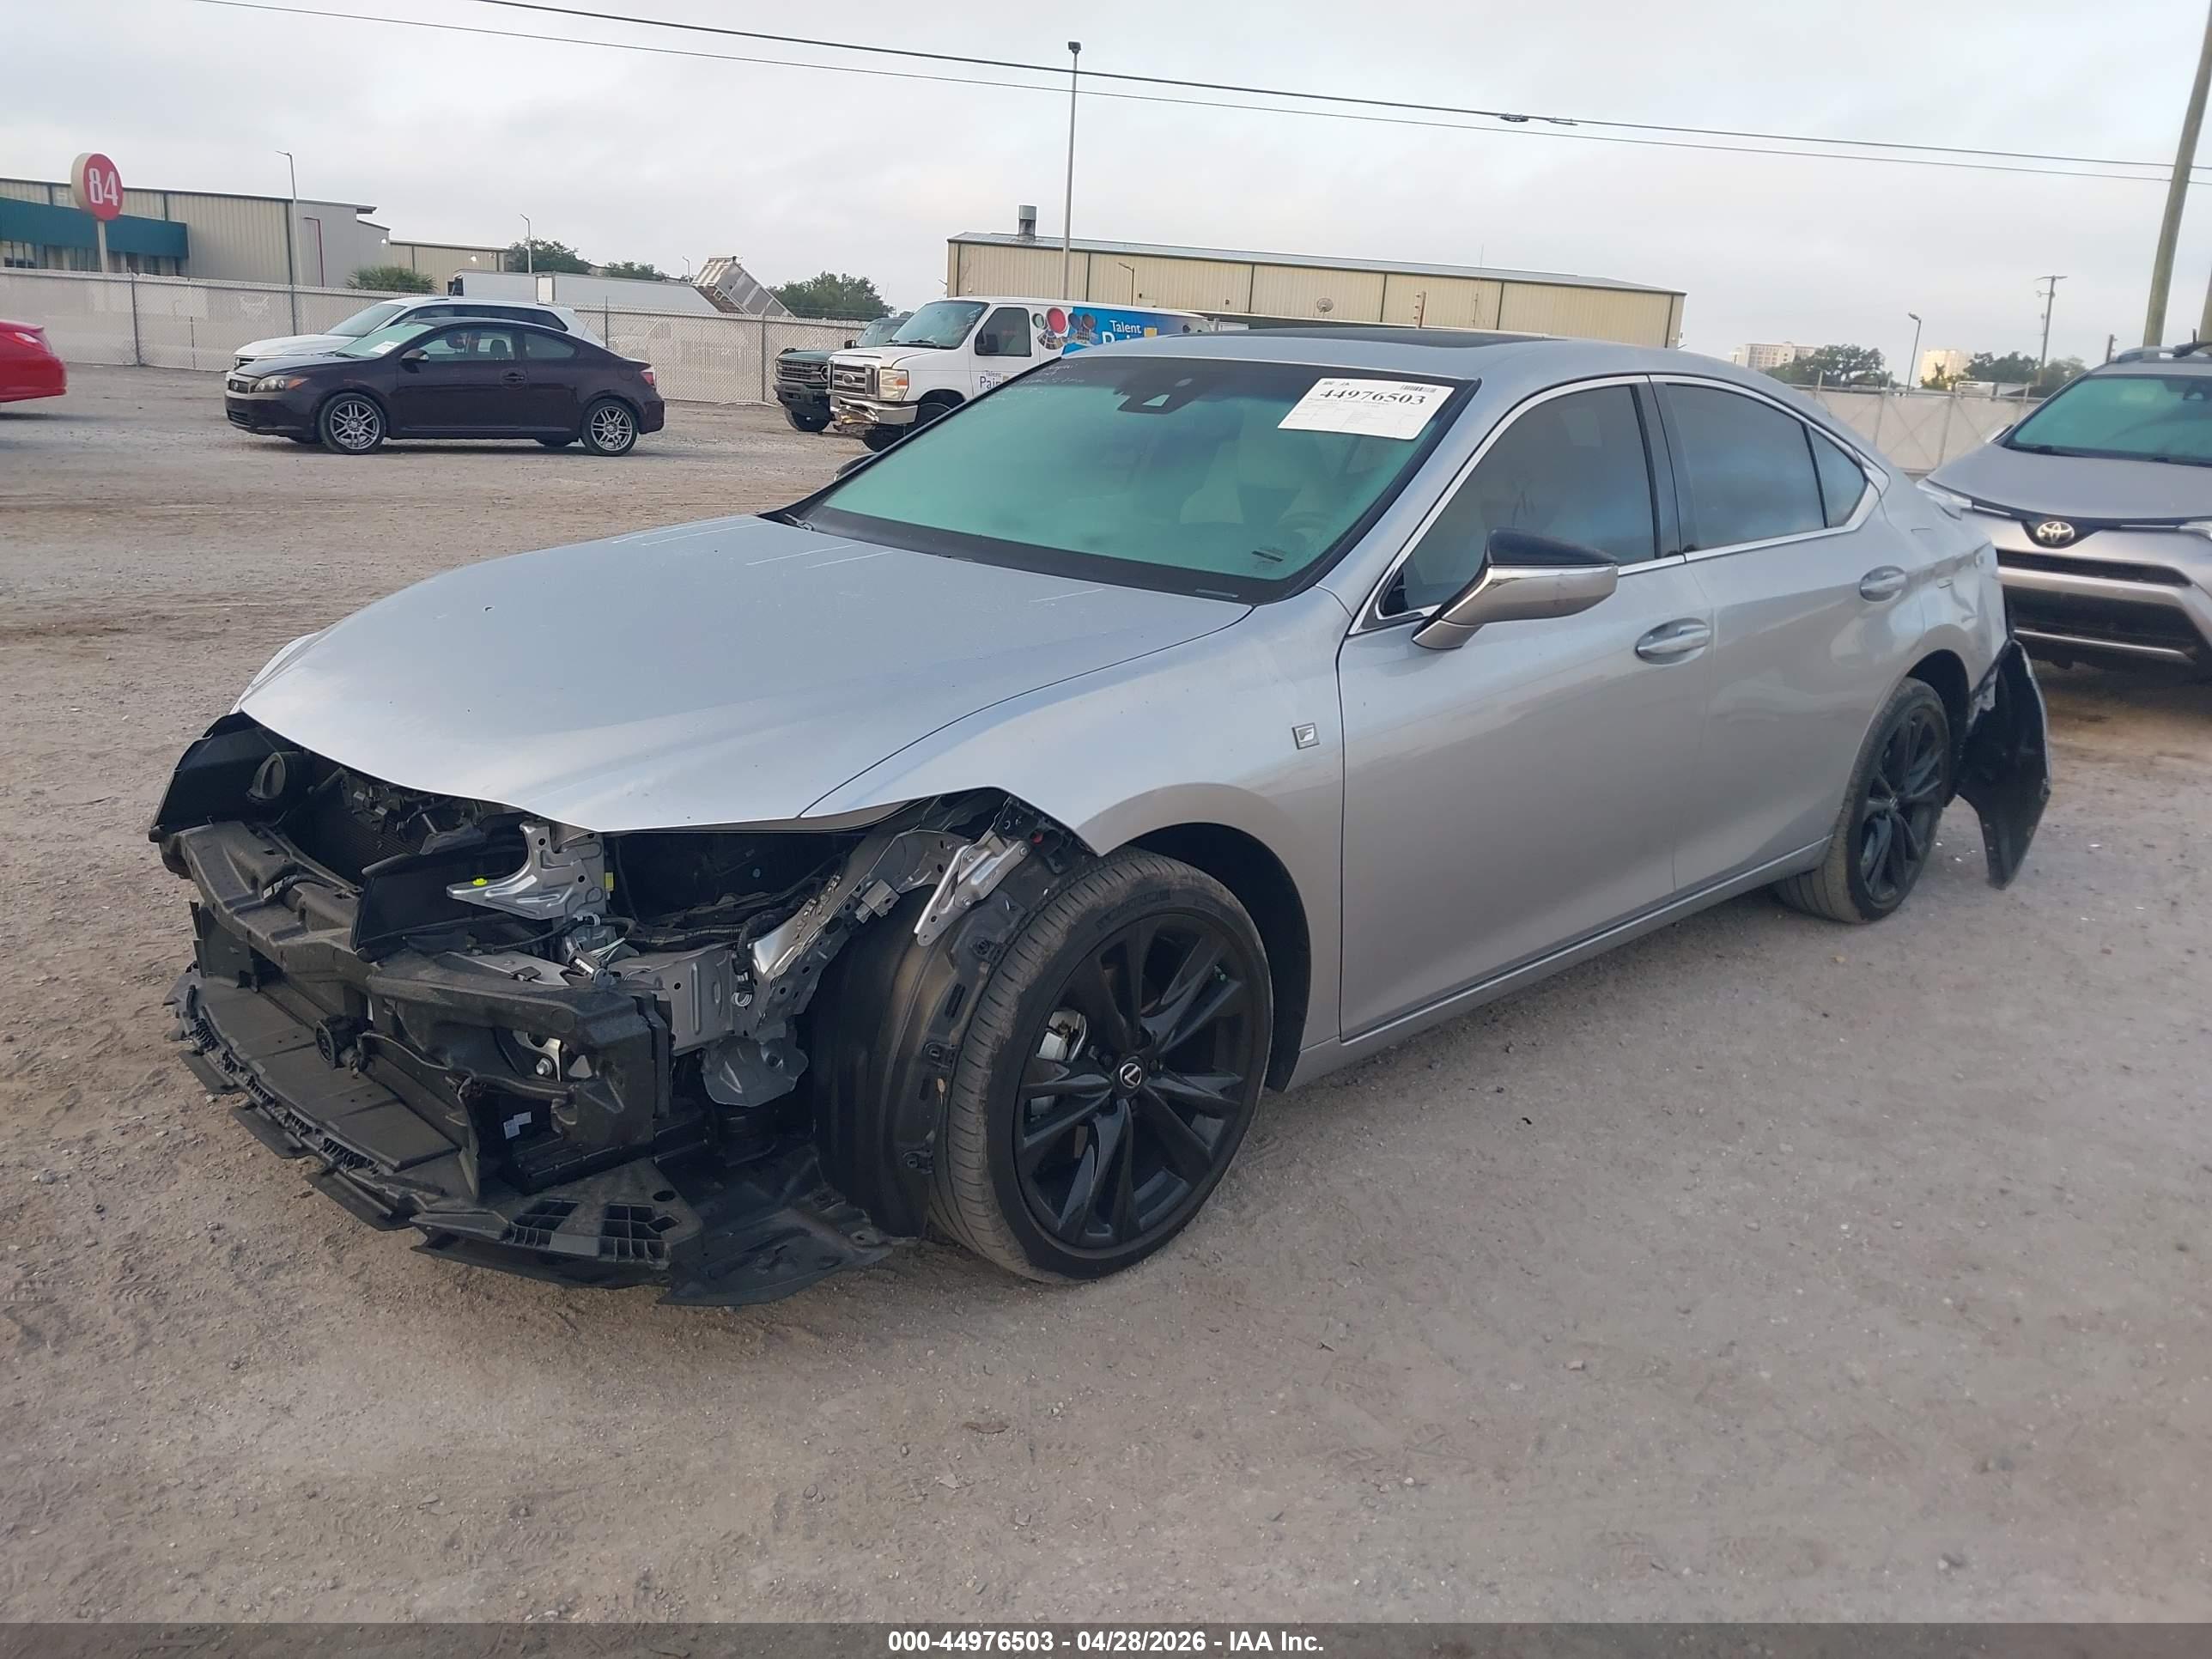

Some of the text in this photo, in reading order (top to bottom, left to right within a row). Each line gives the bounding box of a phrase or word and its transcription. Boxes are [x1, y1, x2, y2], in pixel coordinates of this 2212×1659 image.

[88, 167, 118, 206] 84
[1109, 319, 1142, 334] Talent
[983, 369, 1002, 378] Talent
[1320, 389, 1426, 405] 44976503
